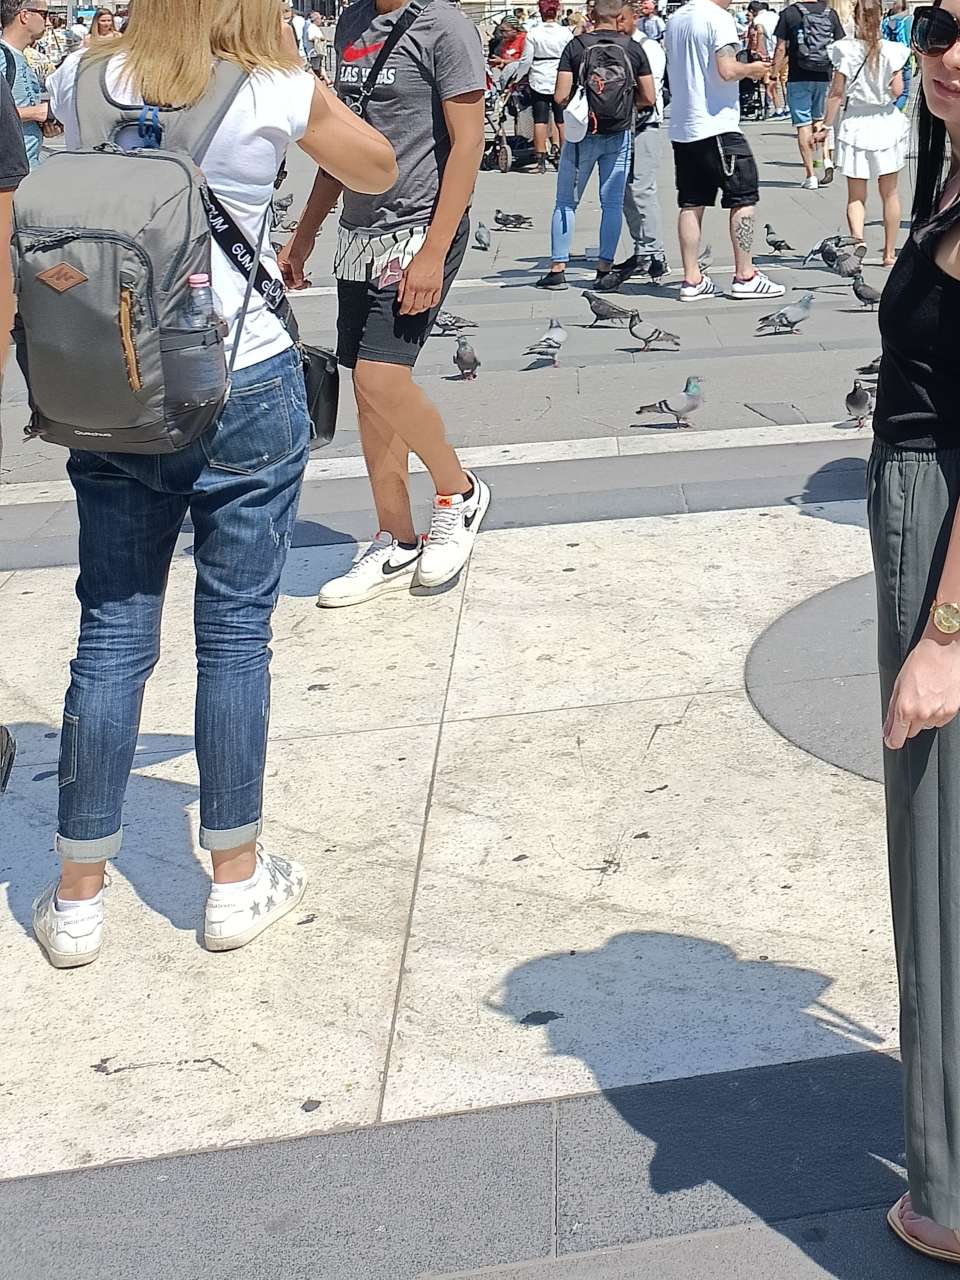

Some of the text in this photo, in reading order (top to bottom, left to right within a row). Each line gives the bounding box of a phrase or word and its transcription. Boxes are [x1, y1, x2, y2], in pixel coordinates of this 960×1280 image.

[340, 66, 396, 84] LAS VAS
[231, 243, 254, 271] GUM
